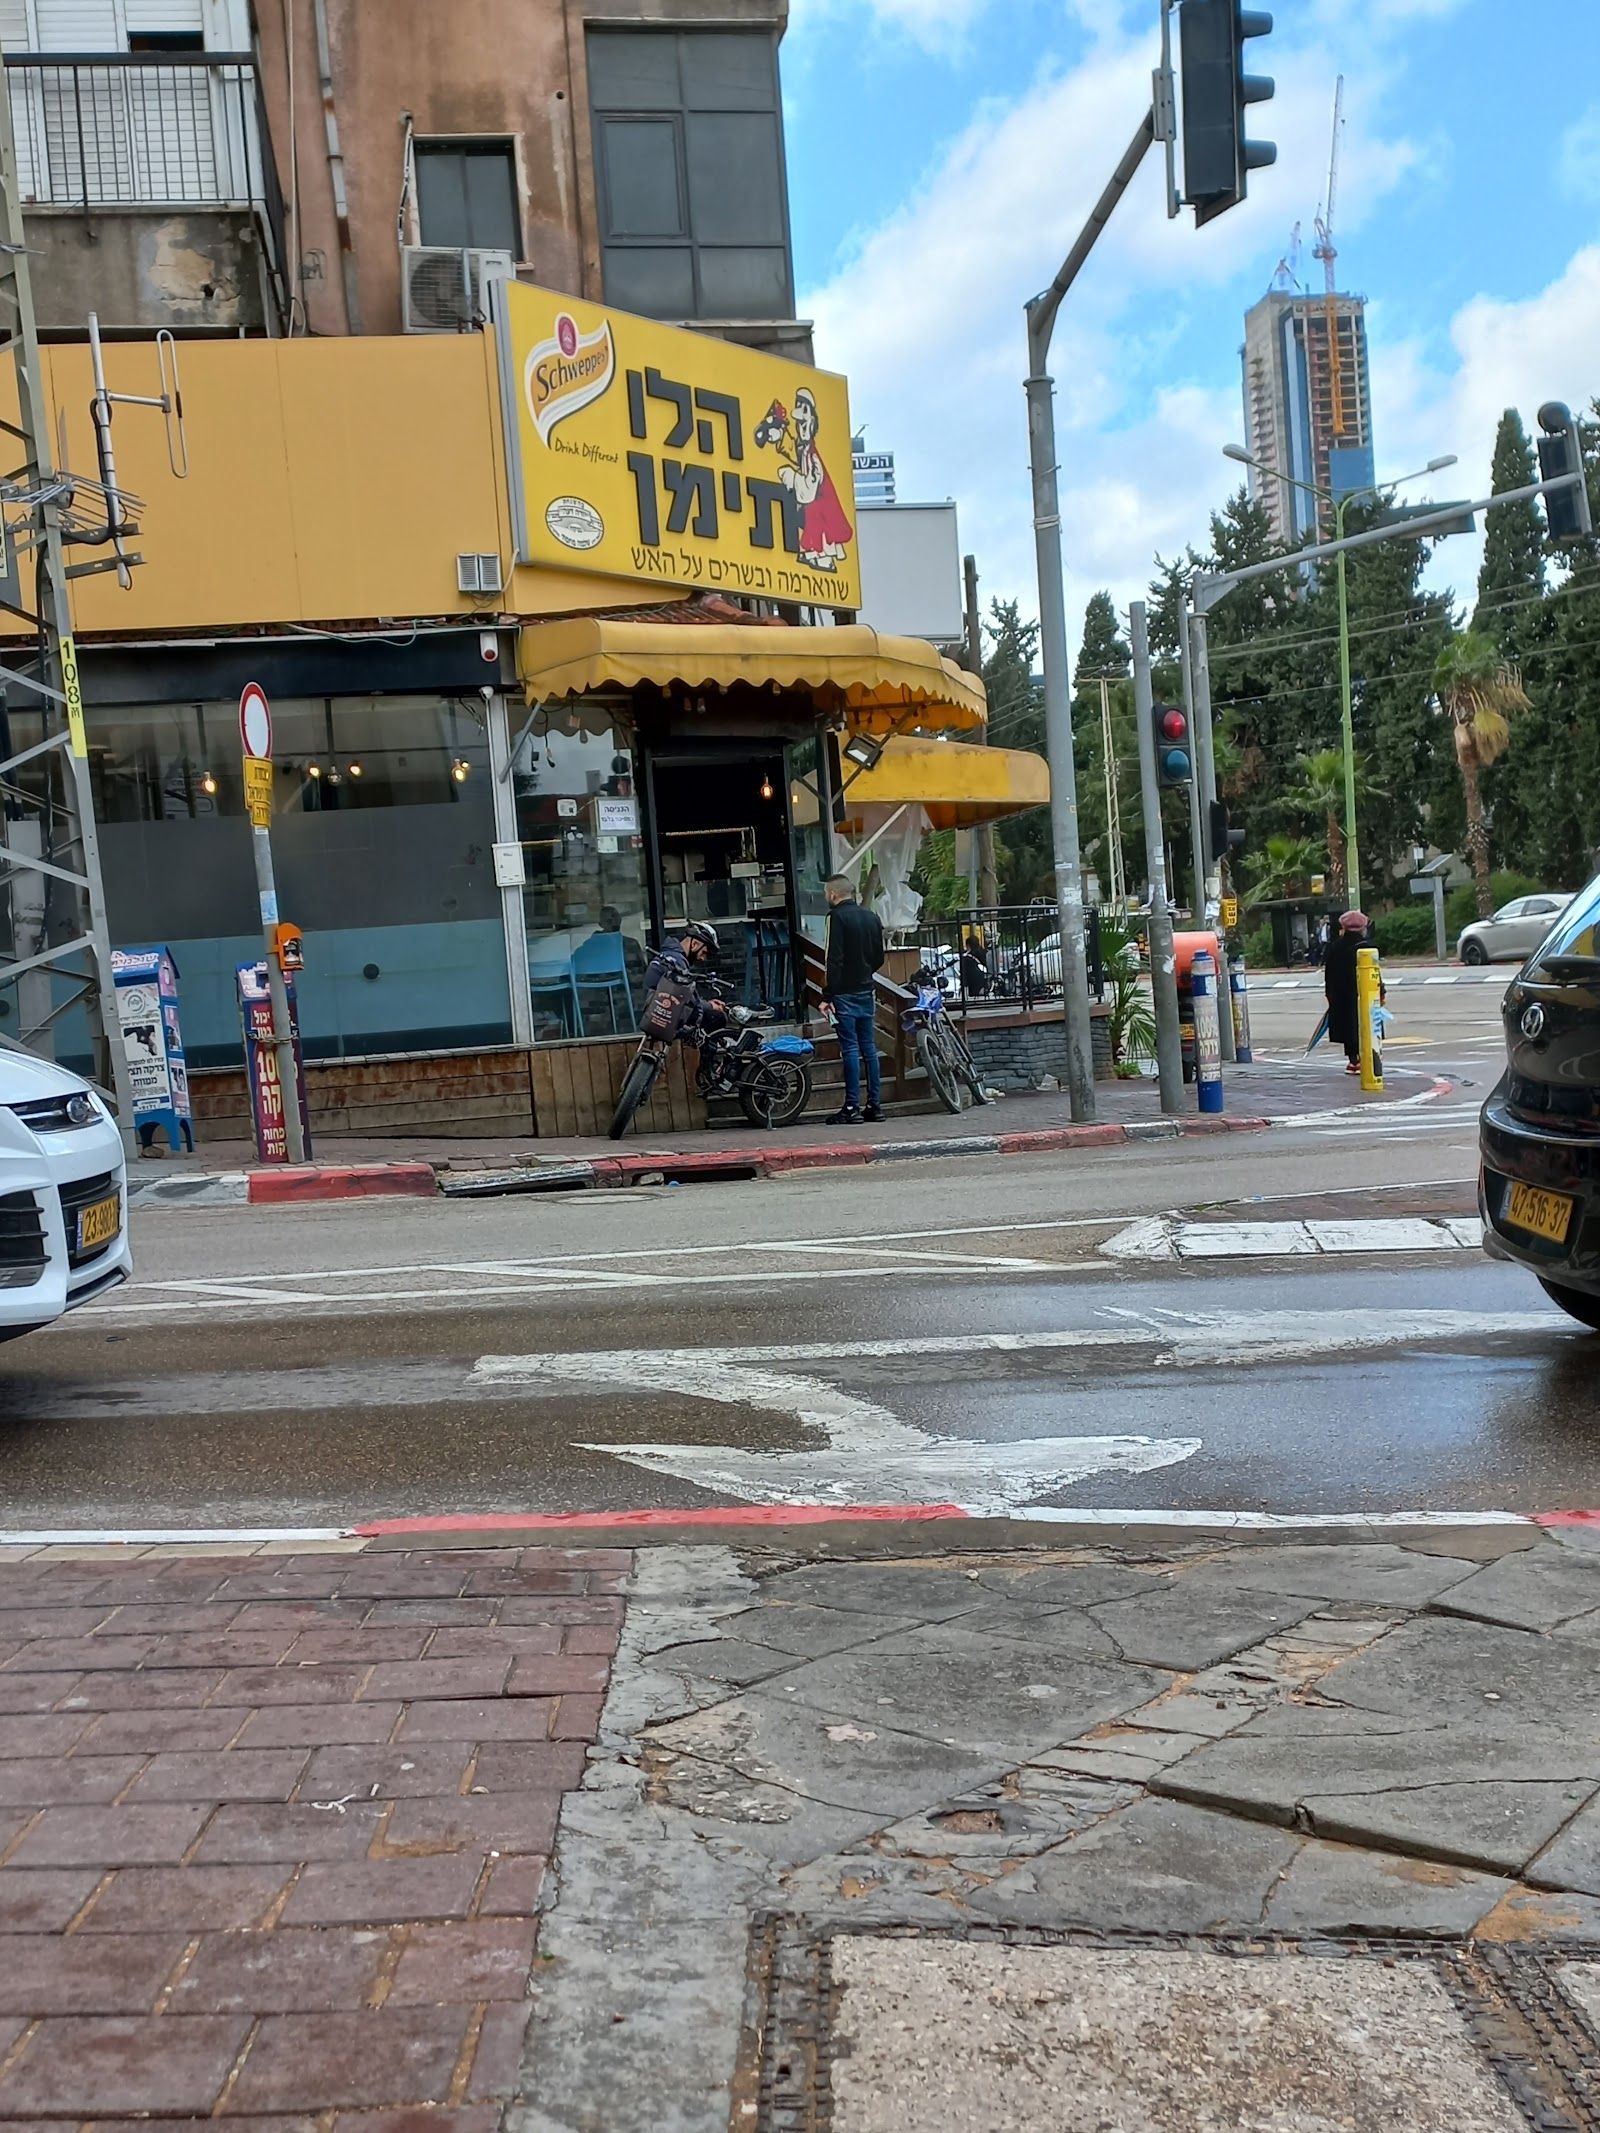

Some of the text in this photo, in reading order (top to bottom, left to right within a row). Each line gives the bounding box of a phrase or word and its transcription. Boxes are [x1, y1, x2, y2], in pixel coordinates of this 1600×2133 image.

[536, 350, 606, 402] Schweppes
[555, 437, 619, 463] Drink Different
[627, 451, 800, 554] תימן
[631, 546, 849, 601] שווארמה ובשרים על האש
[143, 1064, 165, 1078] צדקה
